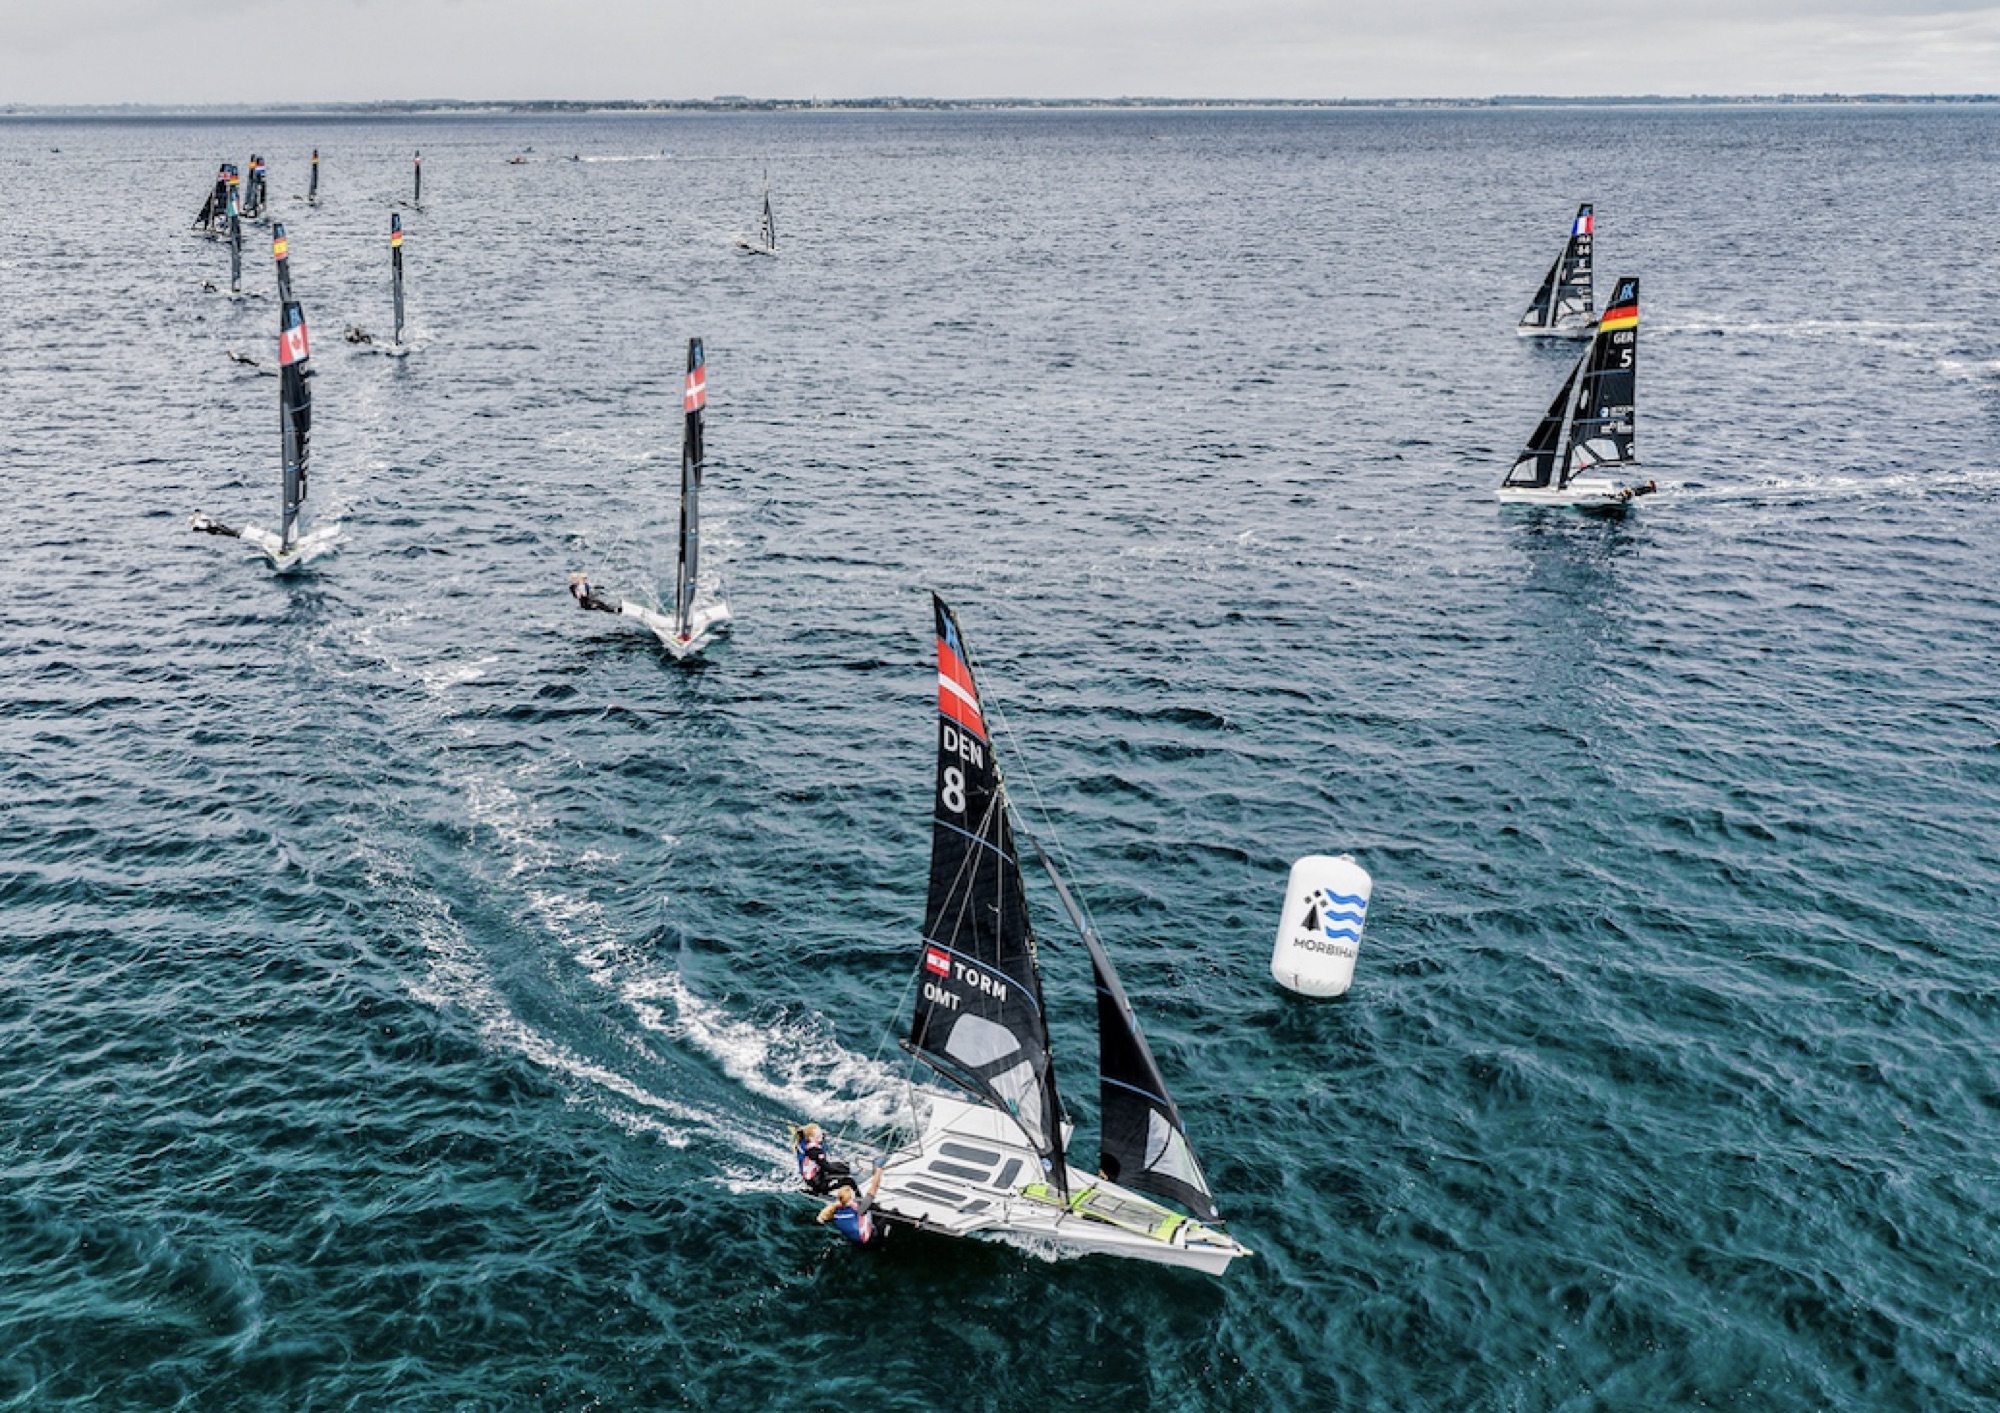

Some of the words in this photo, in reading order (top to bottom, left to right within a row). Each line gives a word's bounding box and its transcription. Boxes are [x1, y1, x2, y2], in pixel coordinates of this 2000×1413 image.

[1613, 331, 1634, 344] GER
[1620, 349, 1632, 368] 5
[944, 726, 984, 769] DEN
[942, 766, 966, 813] 8
[924, 982, 962, 1010] OMT
[954, 963, 1007, 1002] TORM
